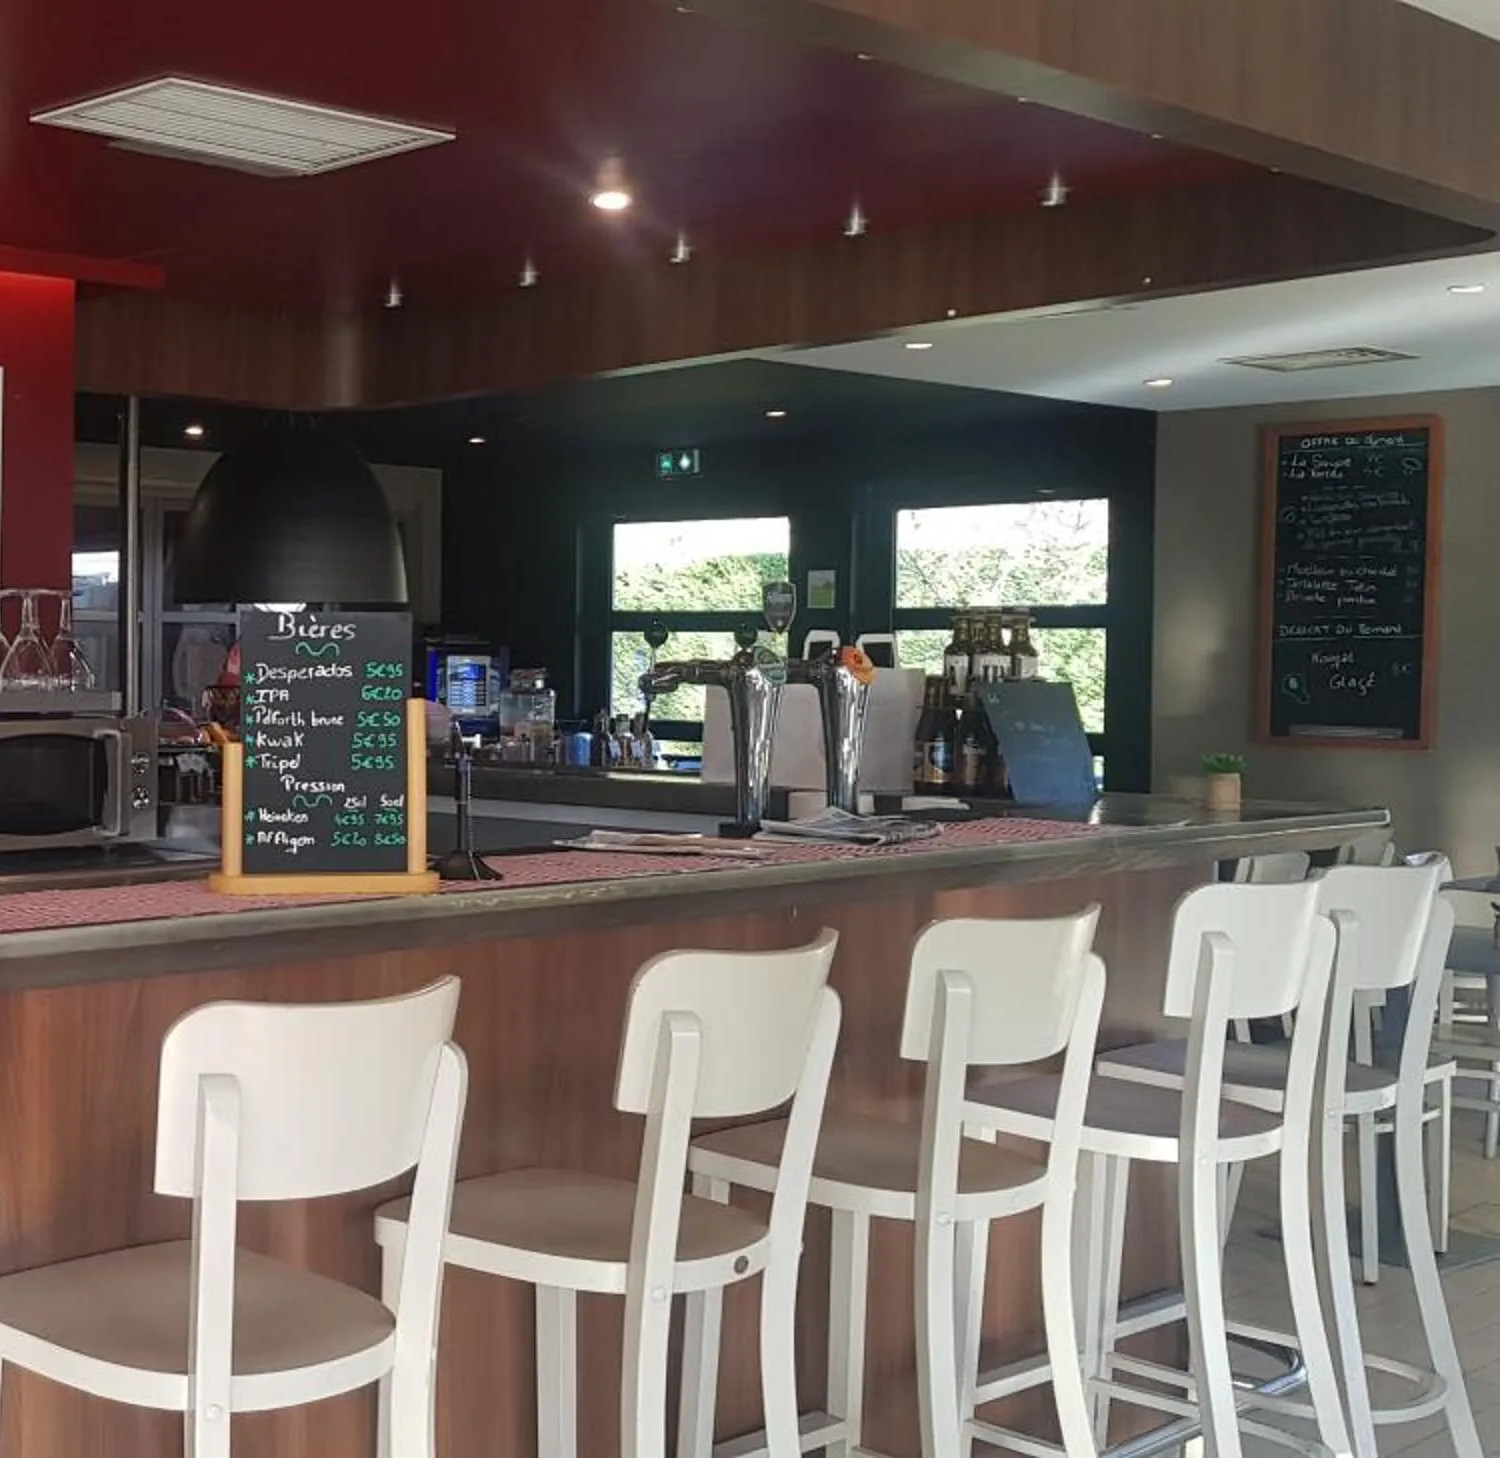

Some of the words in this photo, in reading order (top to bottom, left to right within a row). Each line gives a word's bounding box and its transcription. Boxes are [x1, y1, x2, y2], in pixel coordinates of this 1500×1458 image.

[267, 612, 357, 640] Bières
[254, 662, 353, 684] Desperados
[254, 688, 290, 703] IPA
[279, 773, 346, 793] Pression
[257, 807, 309, 824] Heineken
